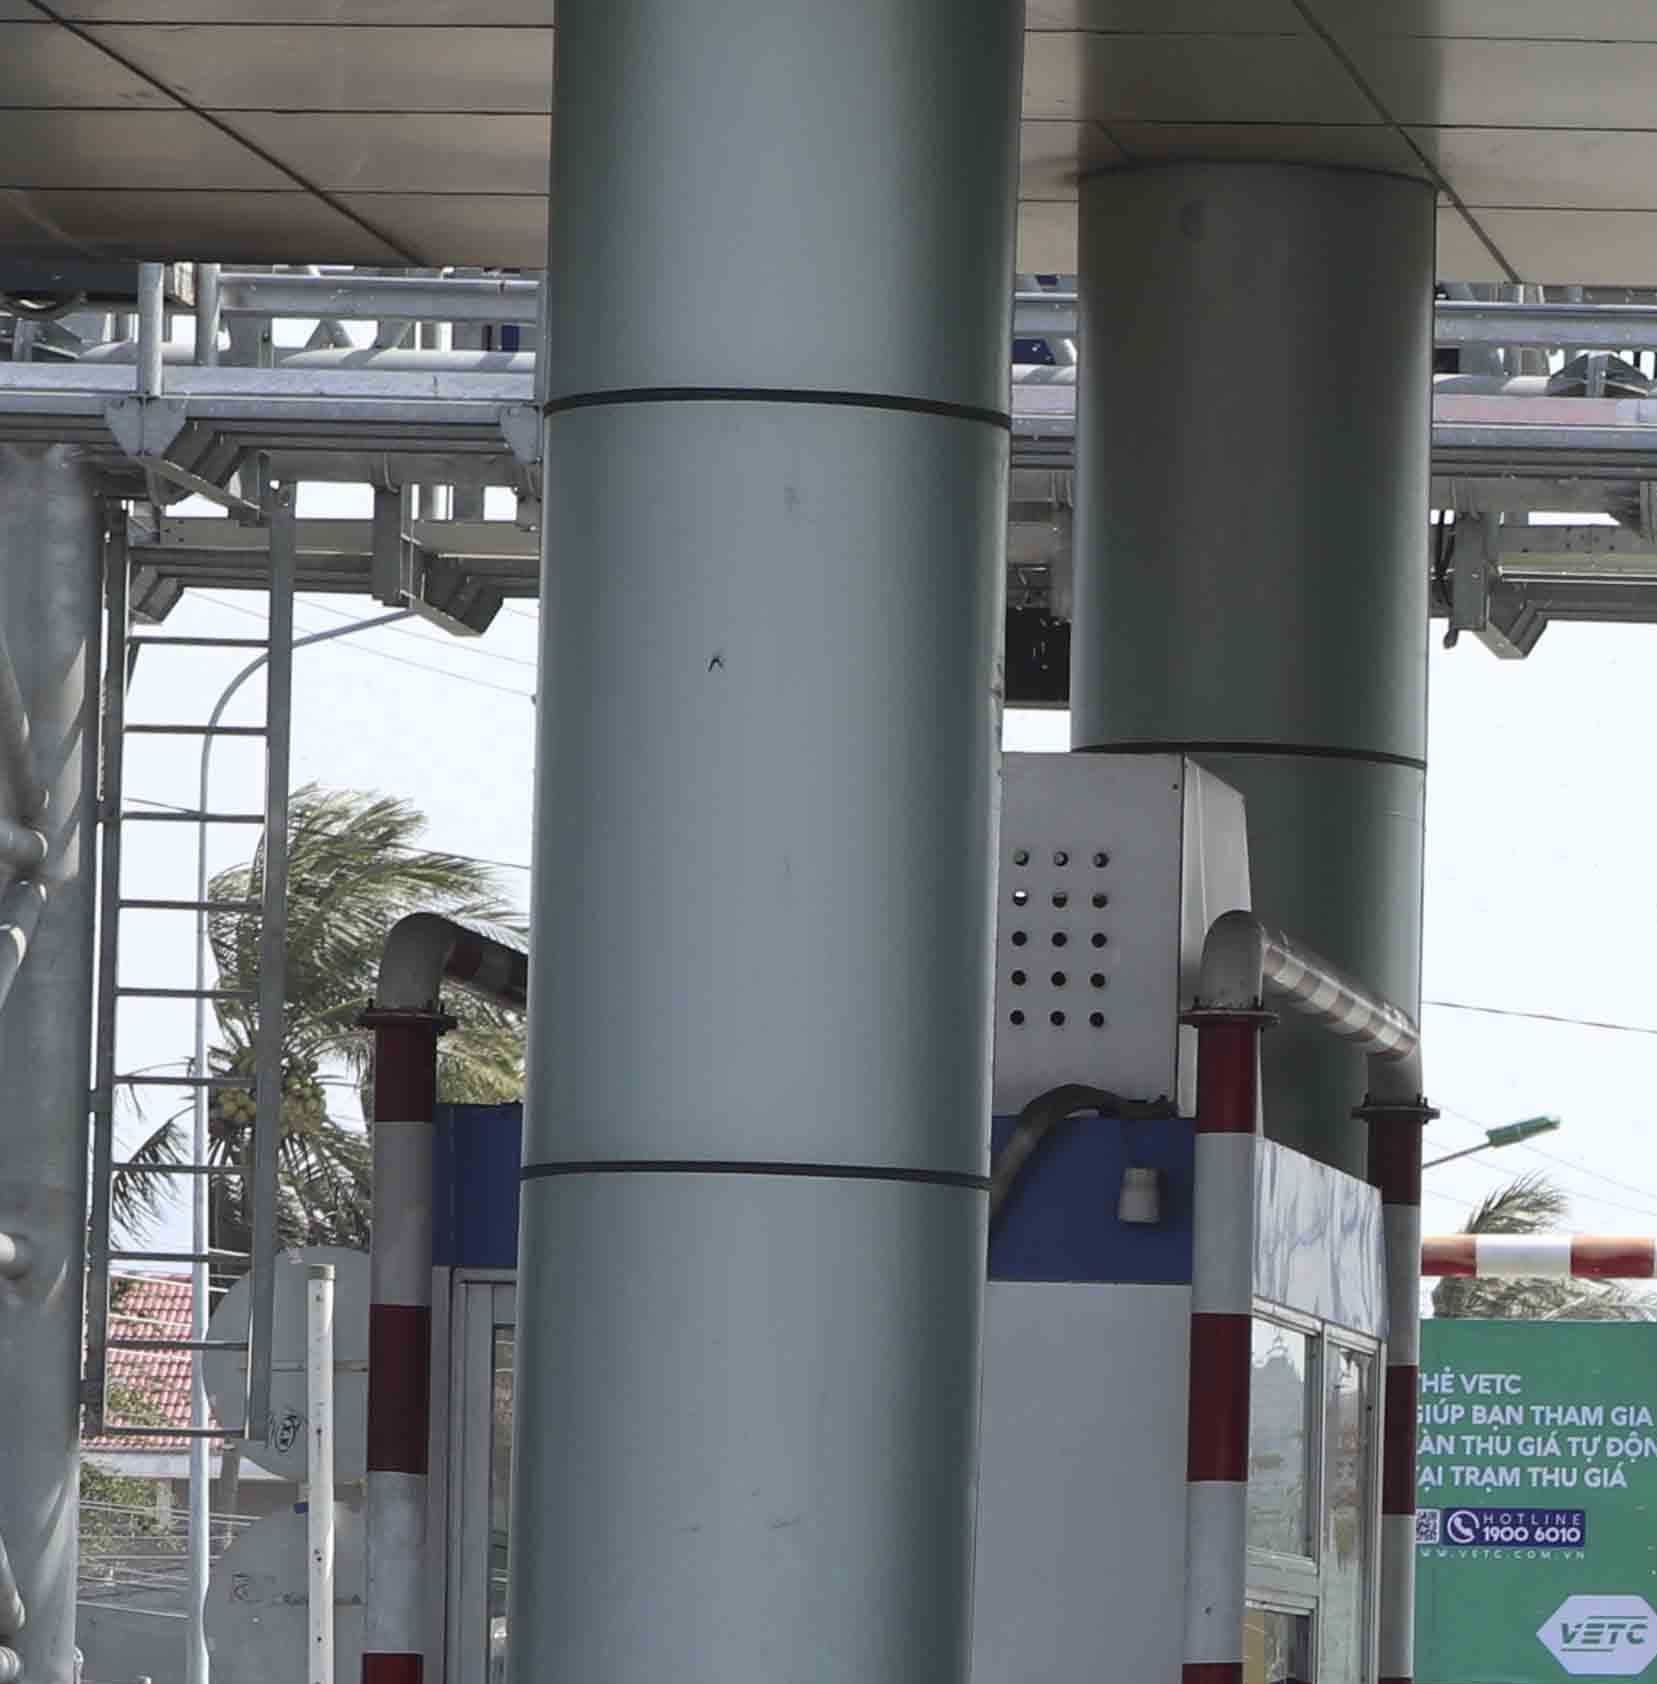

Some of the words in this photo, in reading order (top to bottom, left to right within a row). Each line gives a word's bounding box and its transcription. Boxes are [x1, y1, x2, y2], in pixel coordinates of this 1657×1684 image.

[1417, 1366, 1455, 1395] HẺ
[1460, 1373, 1521, 1395] VETC
[1471, 1404, 1523, 1431] BẠN
[1530, 1405, 1603, 1426] THAM
[1611, 1405, 1654, 1427] GIA
[1417, 1428, 1455, 1456] ÀN
[1461, 1435, 1511, 1456] THU
[1517, 1431, 1561, 1457] GIÁ
[1567, 1436, 1603, 1463] TỰ
[1416, 1465, 1443, 1492] ẠI
[1450, 1466, 1520, 1493] TRẠM
[1528, 1467, 1577, 1488] THU
[1584, 1462, 1628, 1489] GIÁ
[1483, 1513, 1582, 1526] HOTLINE
[1483, 1527, 1529, 1542] 1900
[1534, 1527, 1581, 1542] 6010
[1560, 1623, 1649, 1645] VETC
